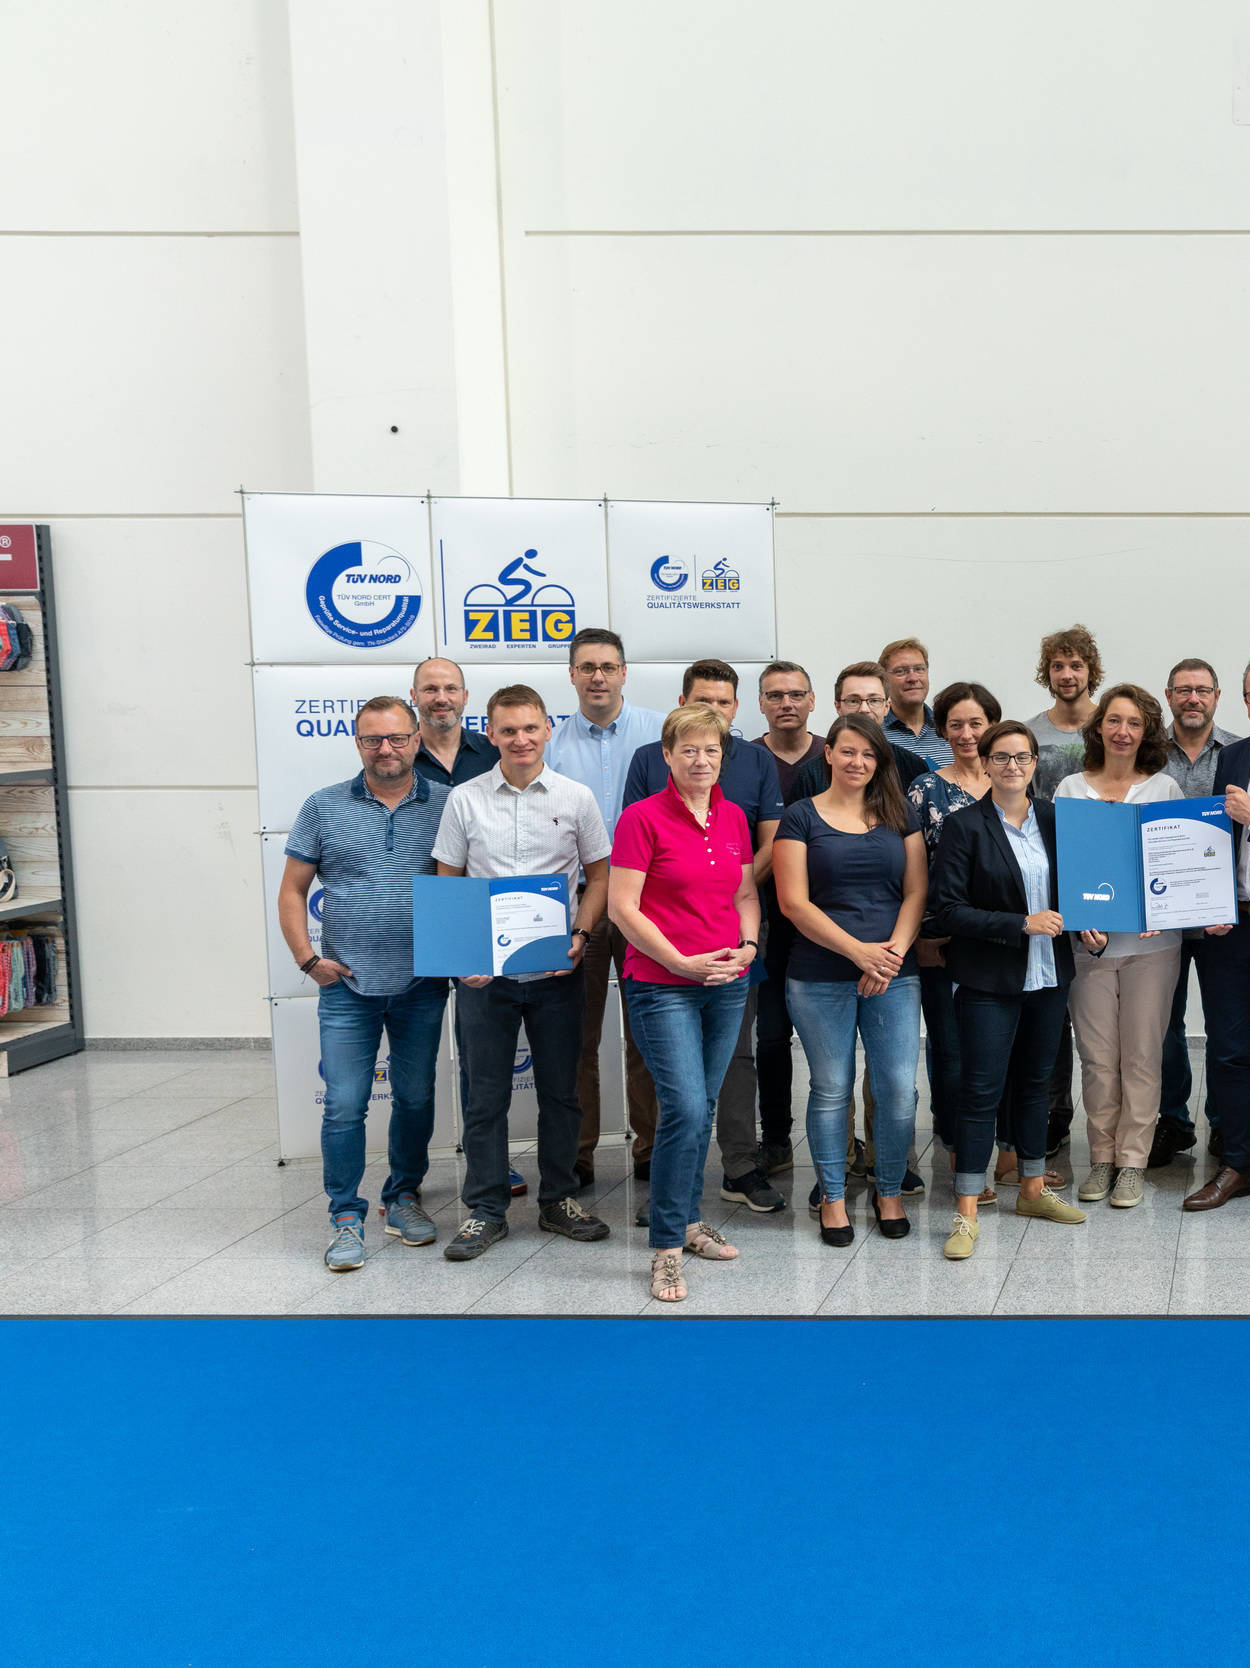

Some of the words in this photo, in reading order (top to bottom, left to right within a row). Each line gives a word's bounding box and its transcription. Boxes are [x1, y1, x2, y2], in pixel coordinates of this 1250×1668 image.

[345, 574, 368, 584] TÜV
[368, 574, 401, 584] NORD
[703, 579, 738, 589] ZEG
[468, 612, 573, 640] ZEG
